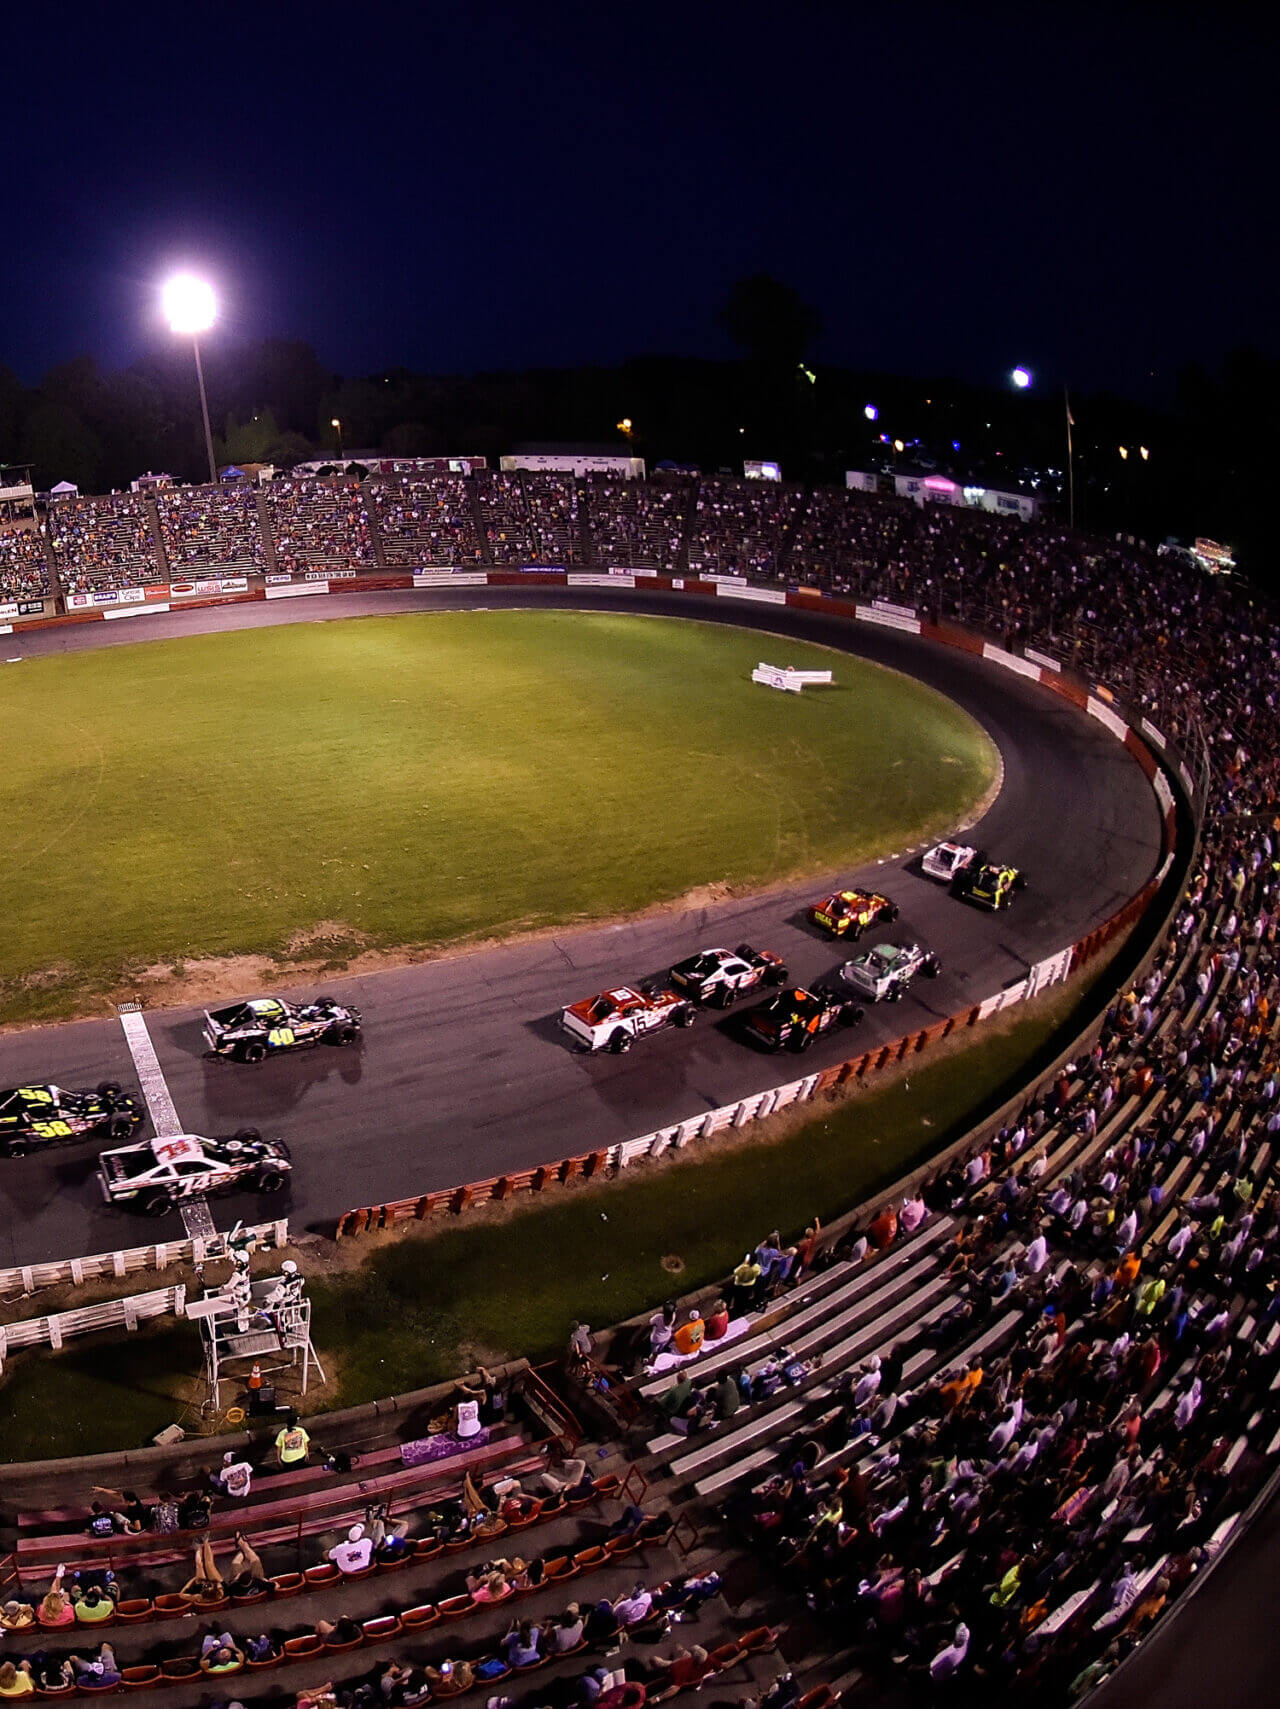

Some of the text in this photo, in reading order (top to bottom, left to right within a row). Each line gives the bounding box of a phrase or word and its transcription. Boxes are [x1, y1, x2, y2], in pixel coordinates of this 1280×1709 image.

[630, 1016, 647, 1035] 15
[268, 1028, 295, 1046] 40
[18, 1088, 53, 1103] 58
[31, 1120, 73, 1138] 58
